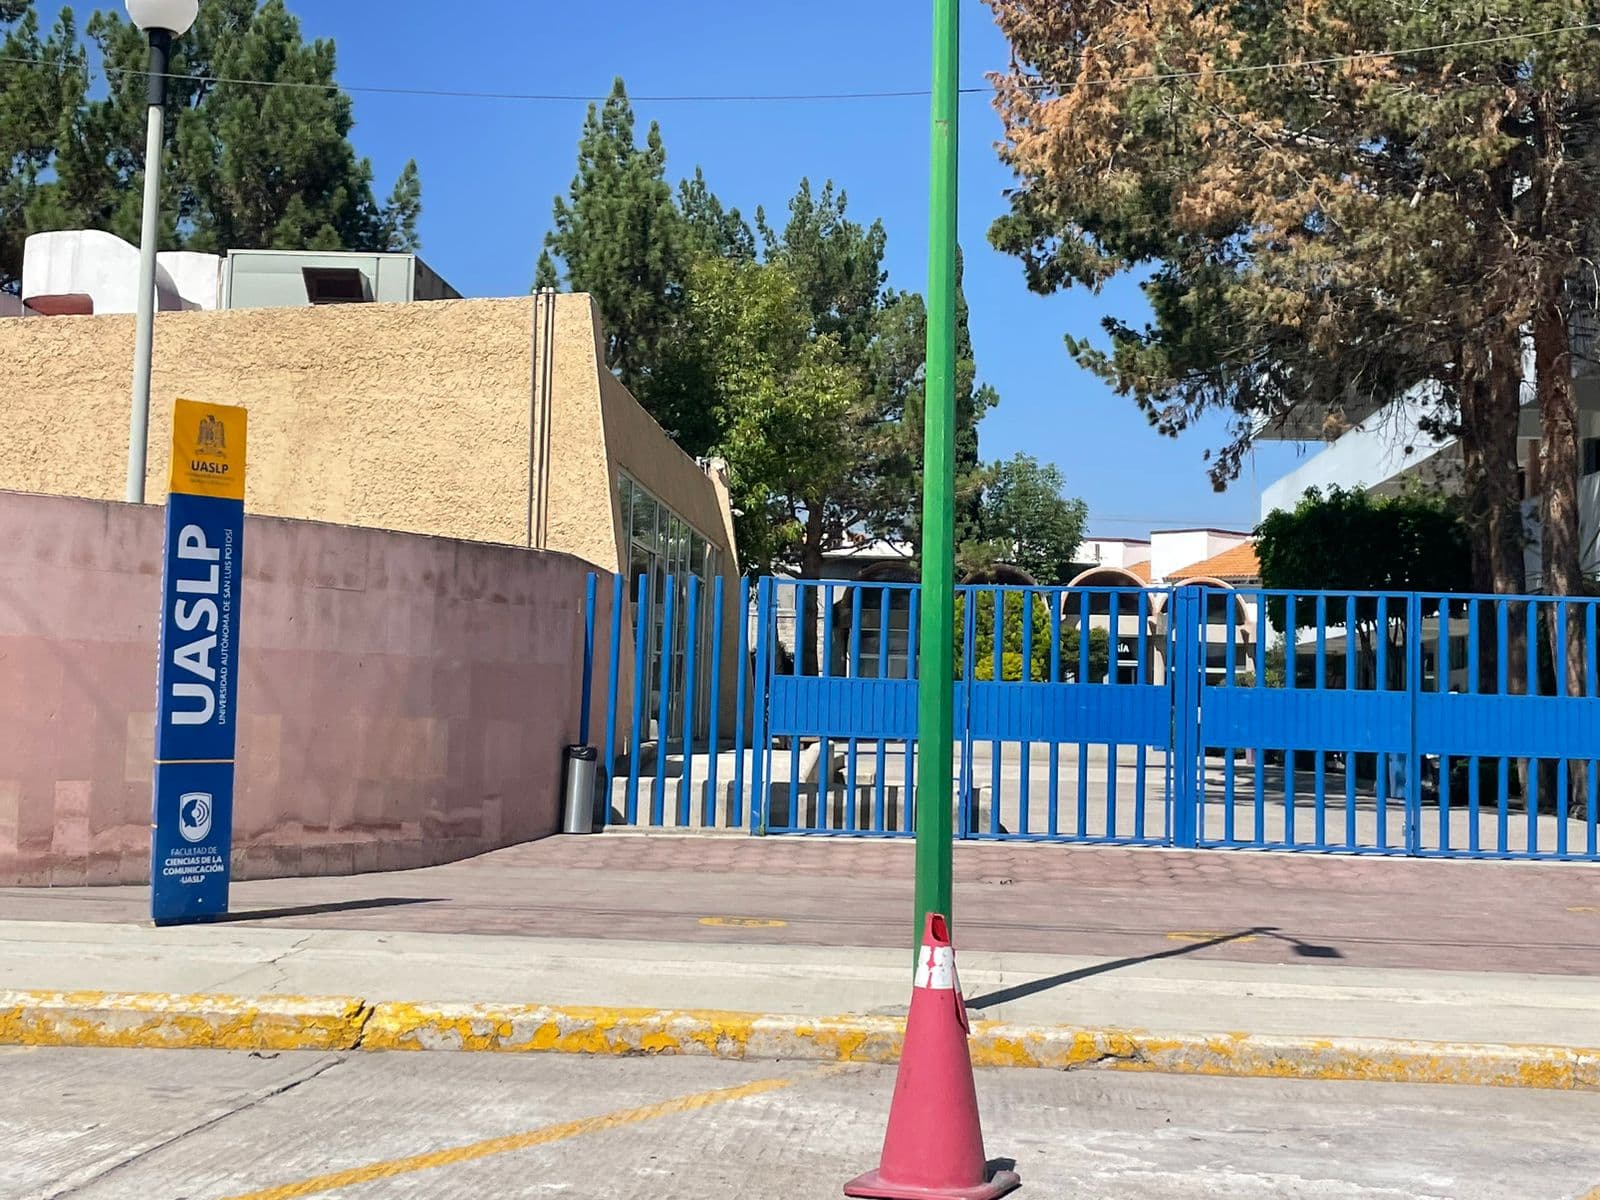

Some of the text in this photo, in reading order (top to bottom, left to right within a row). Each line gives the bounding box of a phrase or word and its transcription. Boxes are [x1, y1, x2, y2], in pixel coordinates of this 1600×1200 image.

[191, 460, 229, 474] UASLP
[172, 524, 220, 725] UASLP
[218, 528, 233, 725] UNIVERSIDAD AUTÓNOMA DE SAN LUIS POTOSÍ
[170, 846, 217, 856] FACULTAD DE
[165, 855, 222, 866] CIENCIAS DE LA
[163, 863, 224, 875] COMUNICACIÓN
